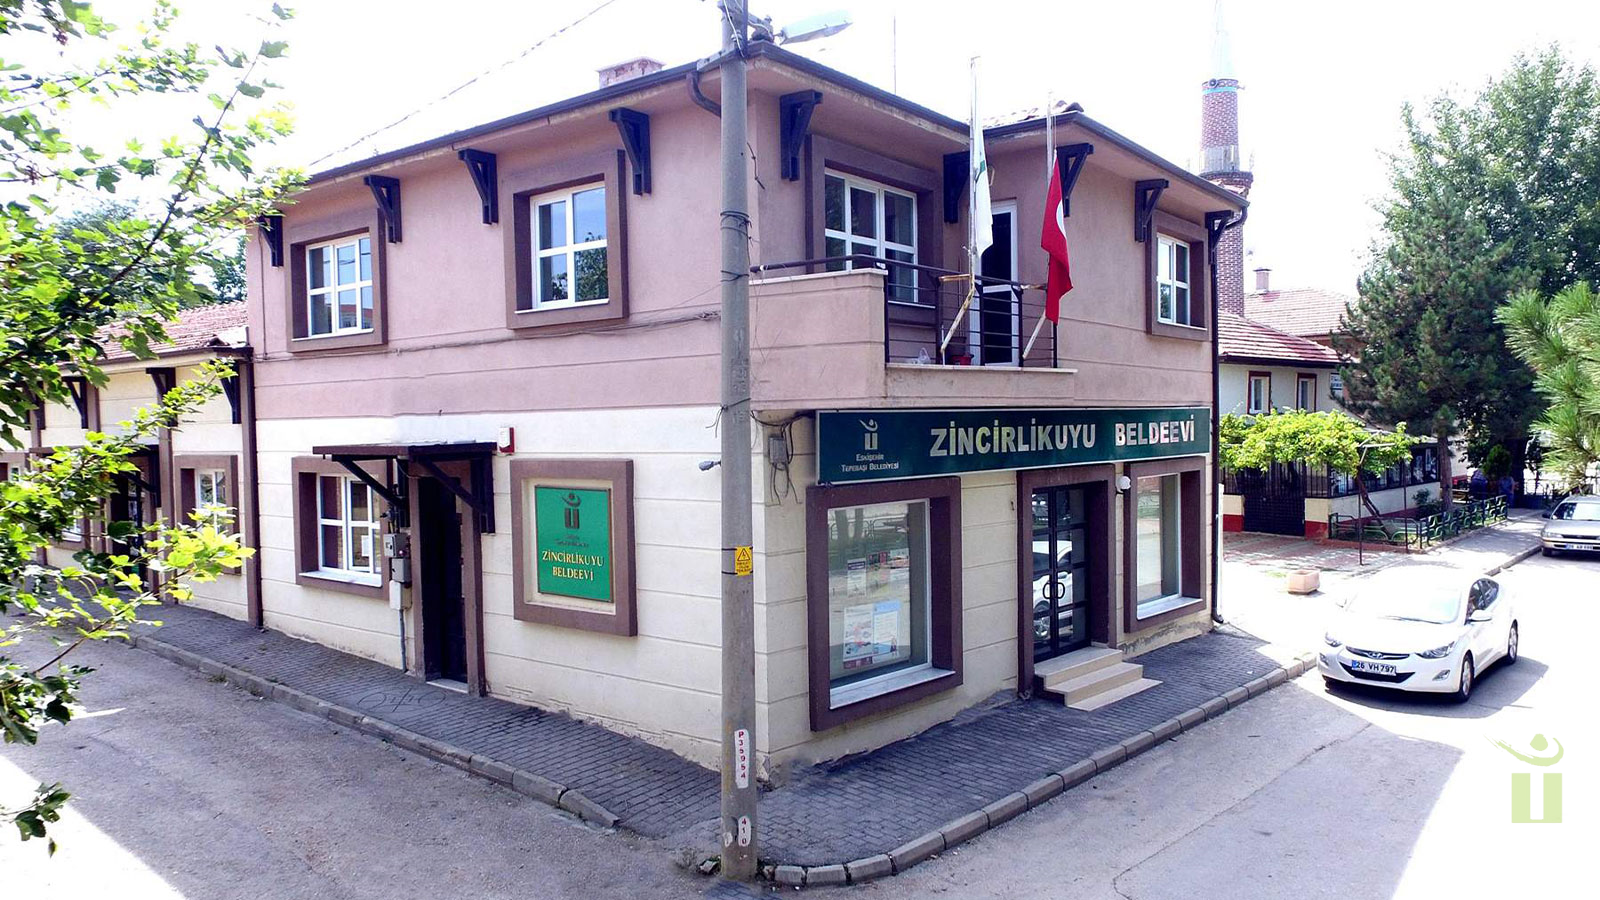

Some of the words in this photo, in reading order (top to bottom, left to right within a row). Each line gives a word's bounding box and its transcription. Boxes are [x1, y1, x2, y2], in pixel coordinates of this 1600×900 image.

[930, 418, 1095, 456] ZİNCİRLİKUYU
[1115, 414, 1194, 446] BELDEEVİ
[542, 549, 604, 566] ZİNCİRLİKUYU
[552, 566, 593, 581] BELDEEVİ
[1356, 661, 1365, 669] 26
[1368, 663, 1379, 671] VH
[1380, 664, 1395, 673] 797
